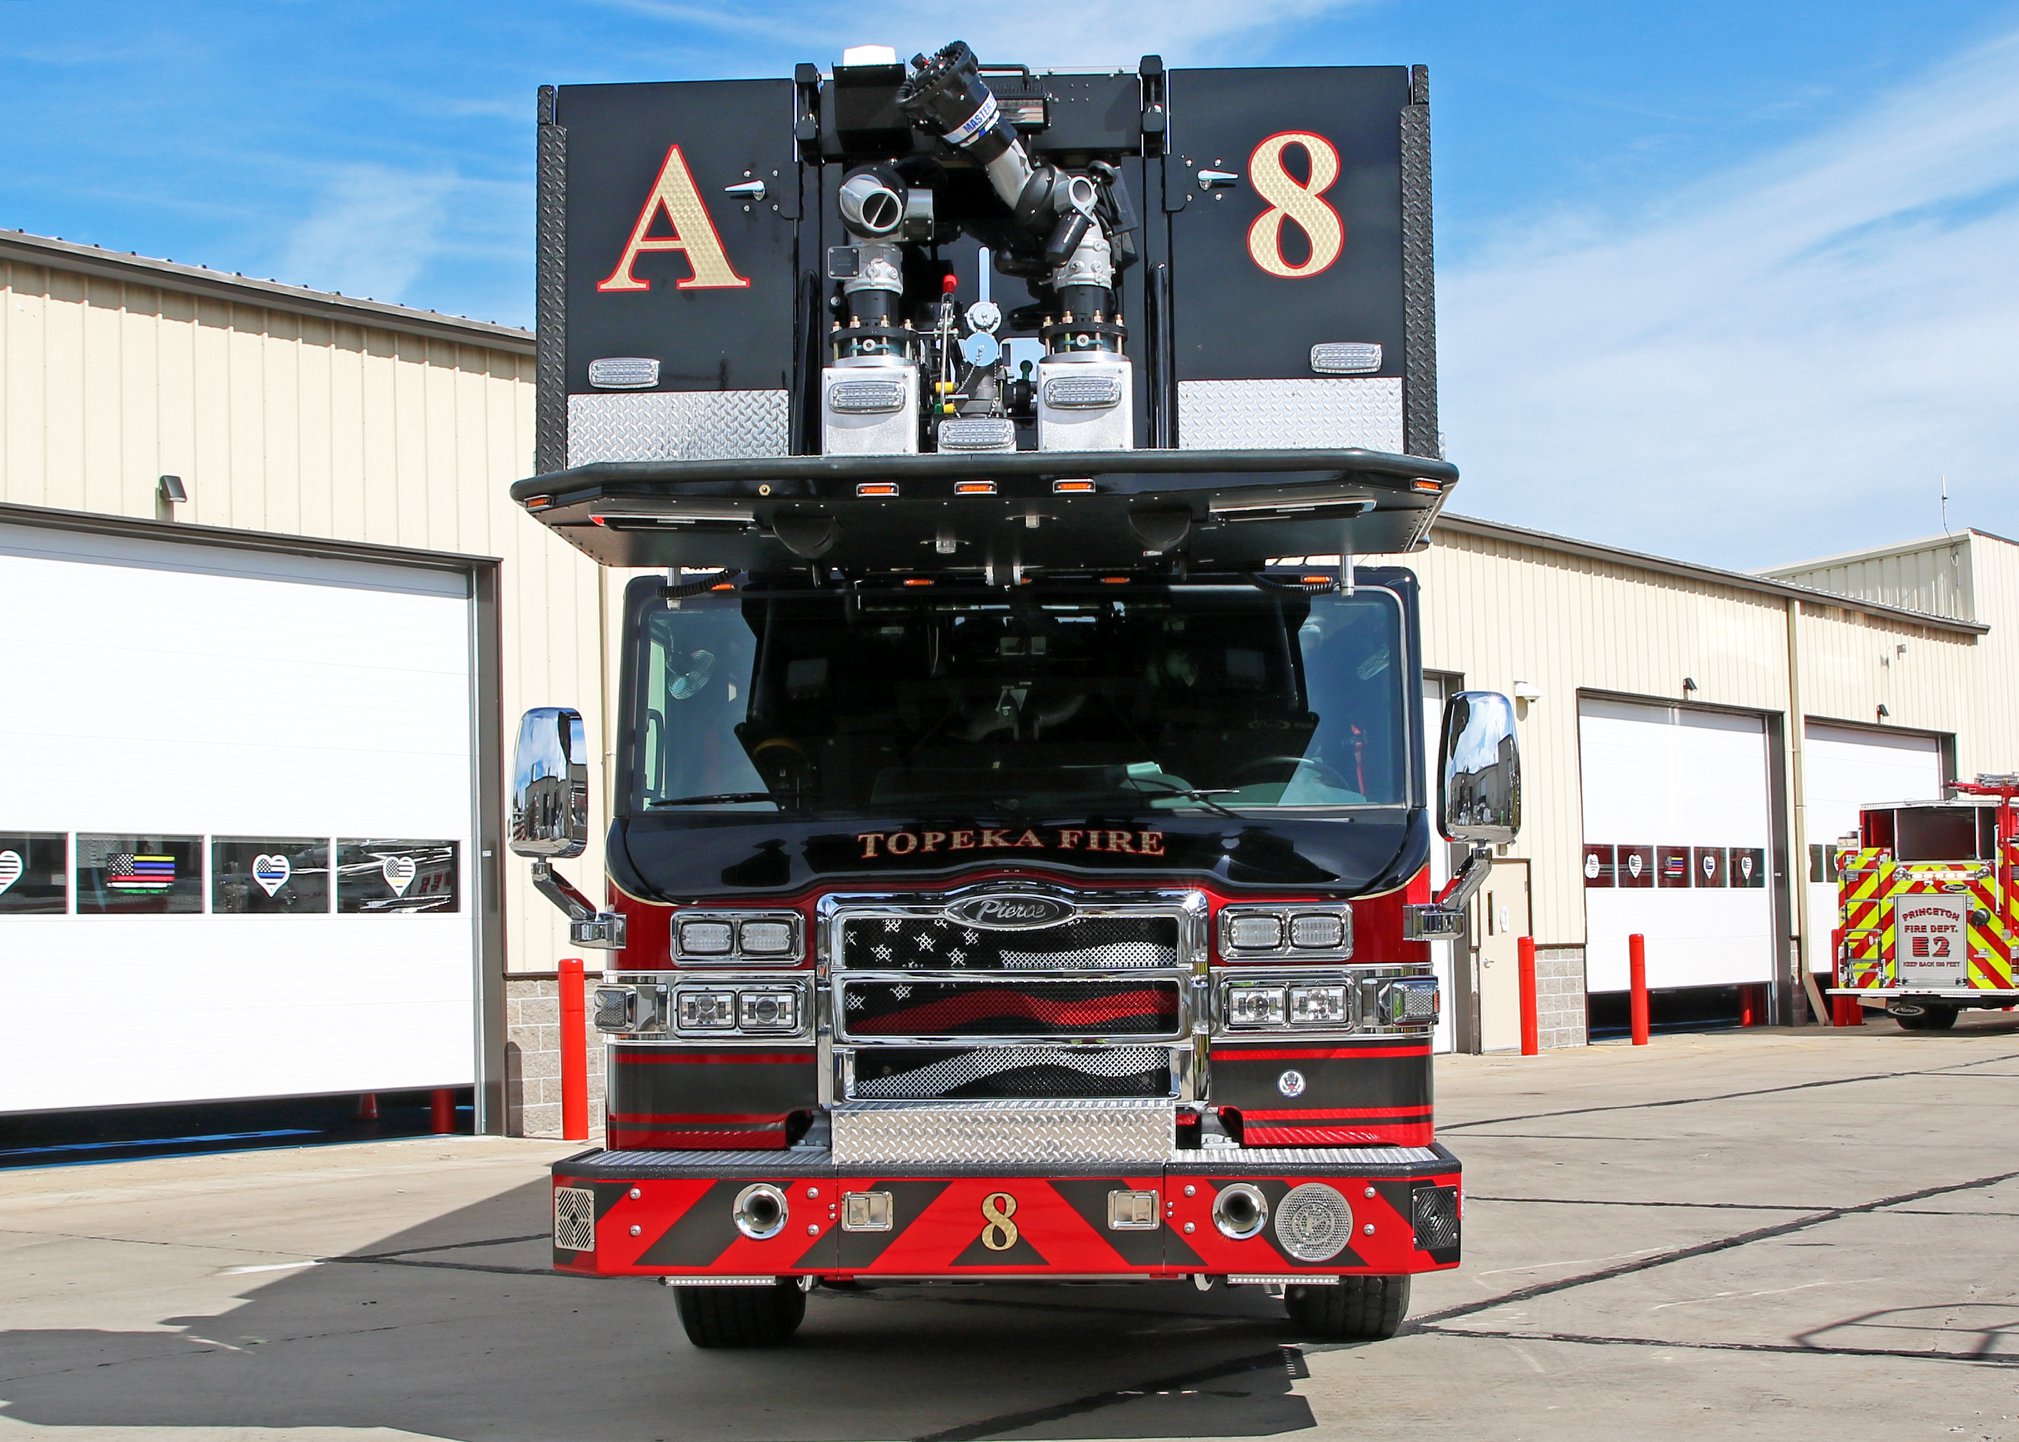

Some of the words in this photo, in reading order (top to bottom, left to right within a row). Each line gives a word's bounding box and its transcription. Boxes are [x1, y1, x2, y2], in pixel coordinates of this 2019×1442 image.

[963, 102, 993, 133] MASTER
[597, 144, 751, 292] A
[1247, 130, 1345, 279] 8
[857, 829, 1045, 859] TOPEKA
[1057, 829, 1166, 857] FIRE
[976, 899, 1046, 922] Pierce
[1902, 907, 1960, 922] PRINCETON
[1904, 924, 1927, 933] FIRE
[981, 1192, 1019, 1251] 8
